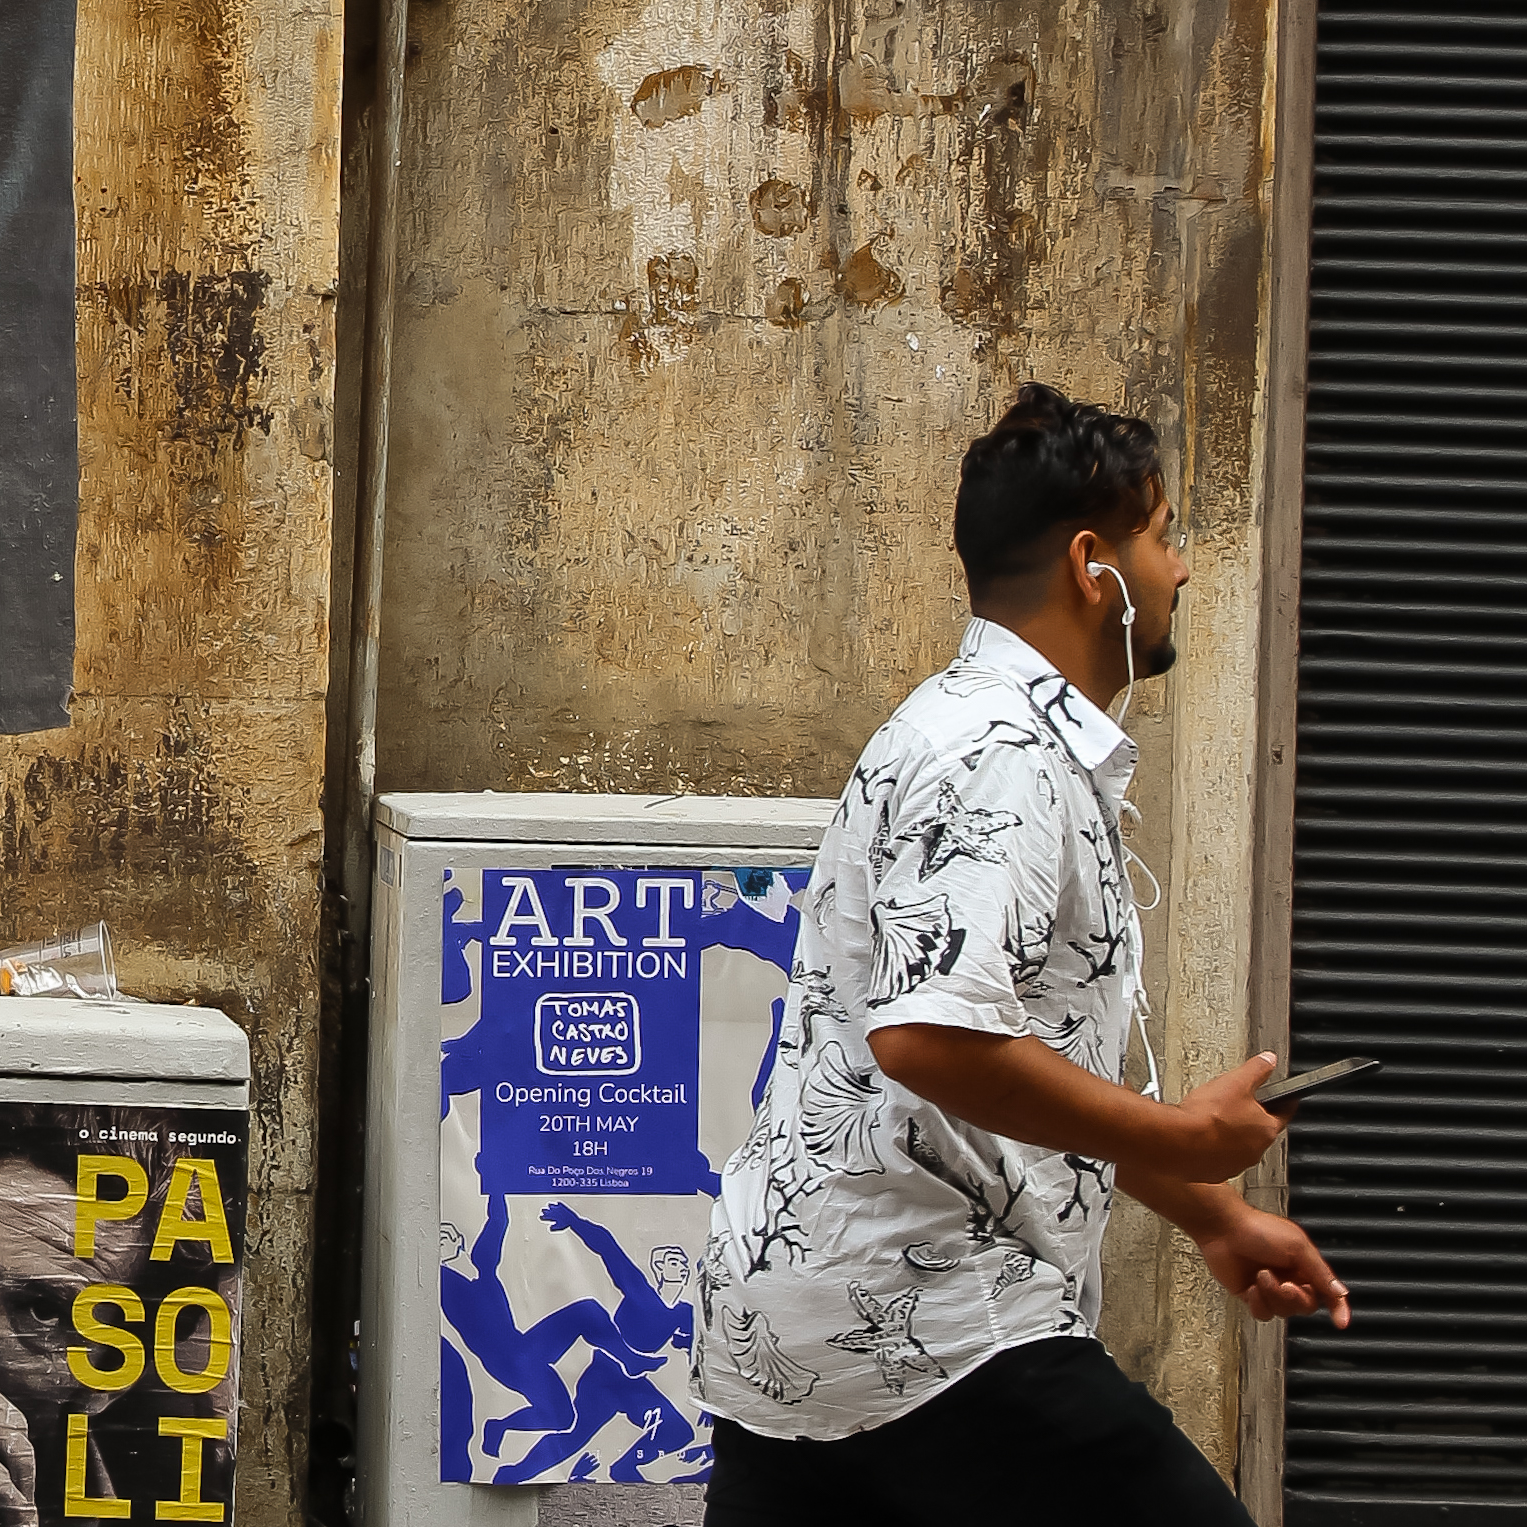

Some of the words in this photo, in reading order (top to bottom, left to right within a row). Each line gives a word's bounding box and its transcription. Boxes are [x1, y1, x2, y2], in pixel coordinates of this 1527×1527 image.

[489, 877, 694, 947] ART
[492, 950, 687, 979] EXHIBITION
[551, 1020, 629, 1042] CASTRO
[550, 1046, 628, 1067] NEVES
[495, 1081, 591, 1108] Opening
[598, 1082, 687, 1104] Cocktail
[78, 1129, 90, 1141] o
[98, 1124, 159, 1143] cinema
[167, 1128, 238, 1147] segundo
[539, 1115, 591, 1133] 20TH
[596, 1115, 639, 1133] MAY
[573, 1140, 608, 1156] 18H
[528, 1166, 546, 1175] Rua
[547, 1166, 561, 1175] Do
[586, 1166, 604, 1175] Dos
[606, 1166, 639, 1177] Negros
[640, 1166, 653, 1176] 19
[551, 1178, 598, 1188] 1200-335
[600, 1178, 630, 1188] Lisboa
[73, 1153, 235, 1264] PA
[66, 1282, 233, 1395] SO
[63, 1412, 227, 1523] LI
